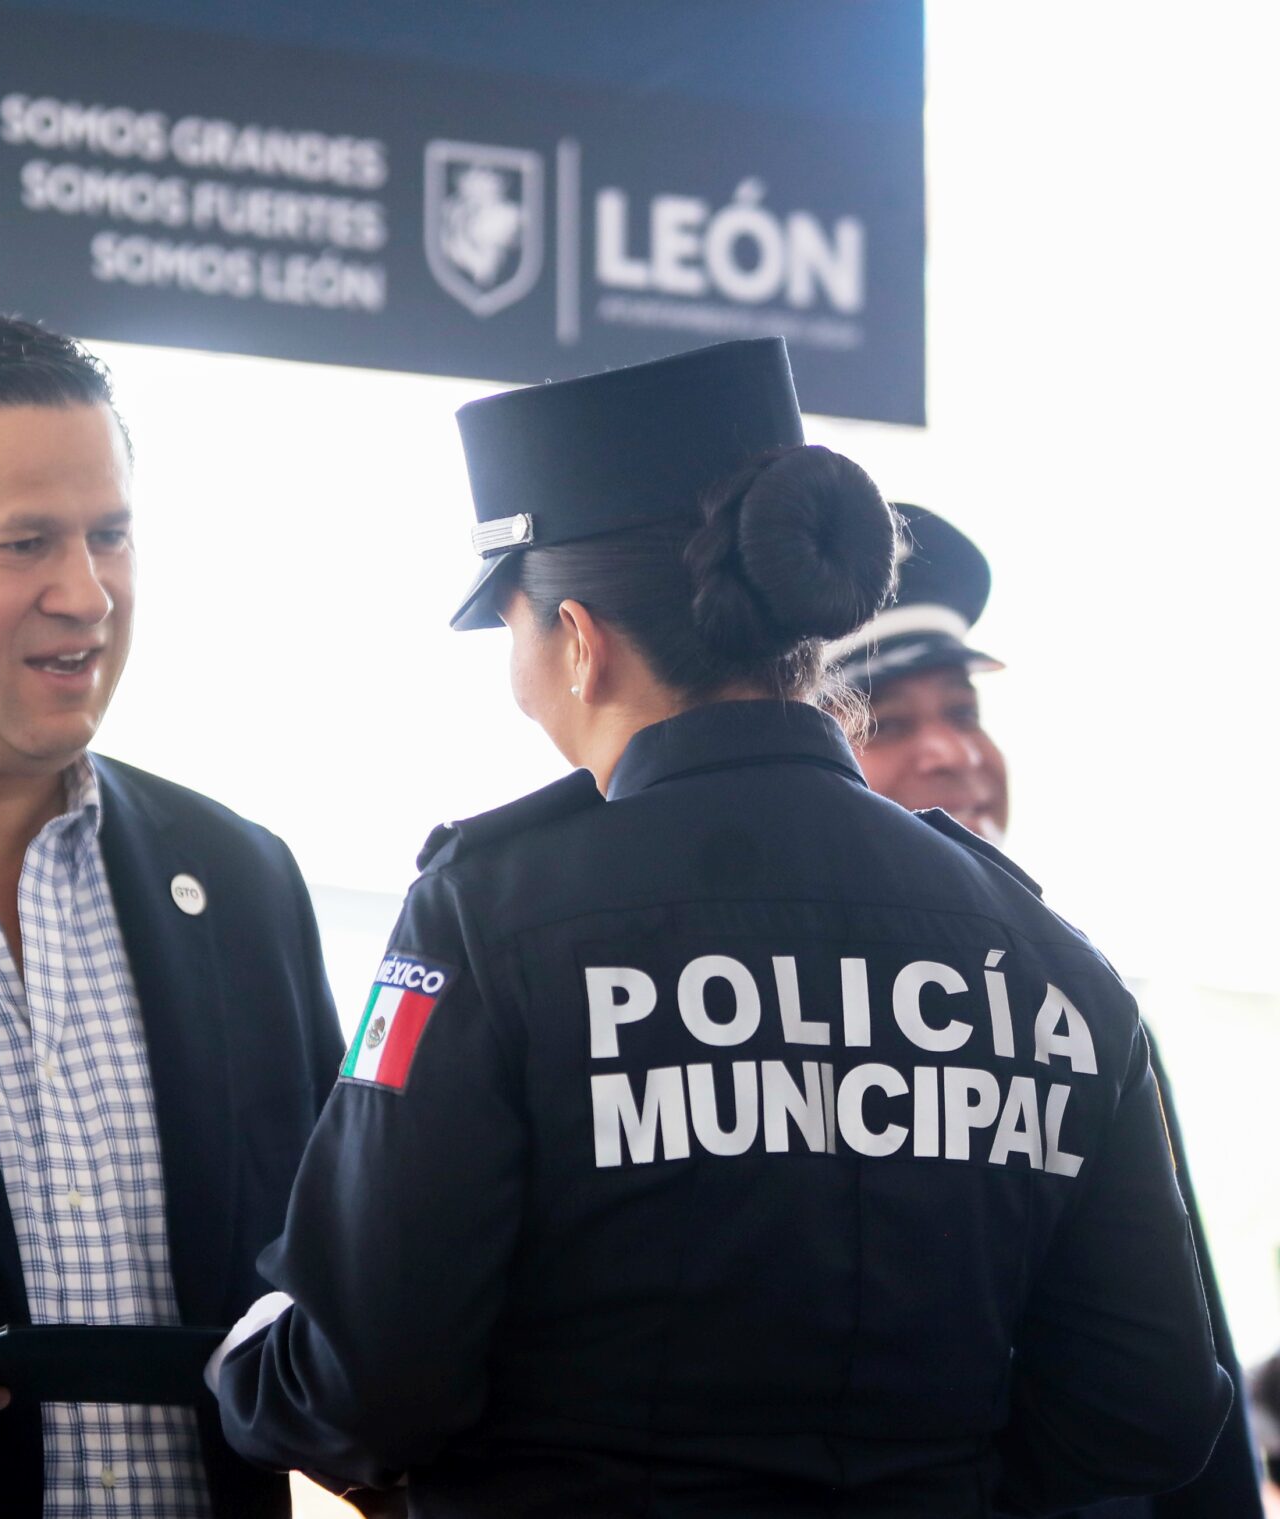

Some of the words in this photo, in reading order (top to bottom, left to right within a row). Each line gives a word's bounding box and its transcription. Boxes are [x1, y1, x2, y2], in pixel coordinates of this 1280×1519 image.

[0, 95, 167, 161] SOMOS
[171, 117, 387, 189] GRANDES
[22, 161, 190, 227] SOMOS
[191, 181, 387, 251] FUERTES
[595, 177, 866, 316] LEÓN
[91, 232, 257, 298] SOMOS
[260, 247, 388, 311] LEÓN
[585, 949, 1099, 1076] POLICÍA
[590, 1060, 1085, 1178] MUNICIPAL
